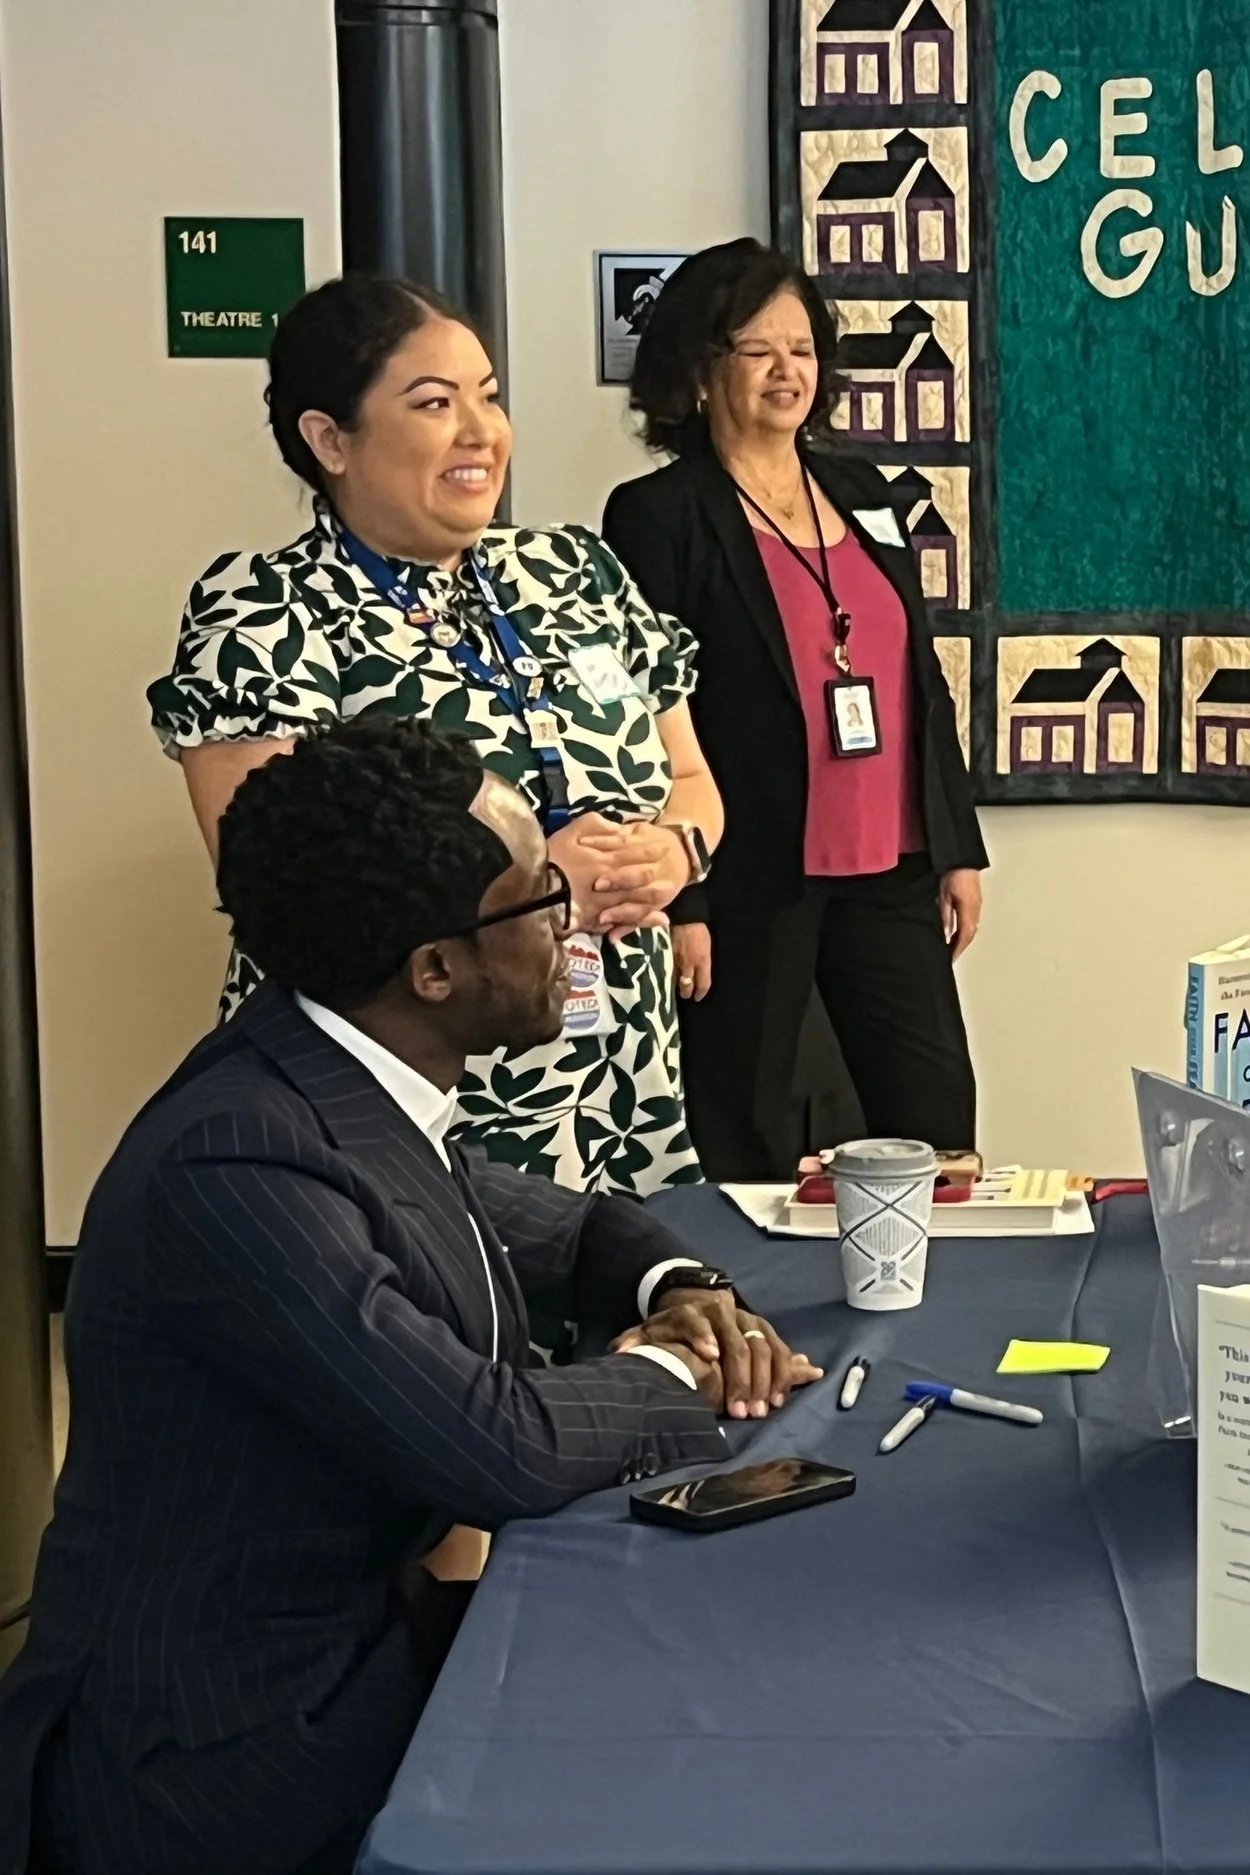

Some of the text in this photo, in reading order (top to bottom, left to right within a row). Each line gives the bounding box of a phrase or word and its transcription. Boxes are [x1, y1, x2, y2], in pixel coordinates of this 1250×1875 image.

[178, 230, 217, 254] 141
[180, 311, 279, 328] THEATRE 1
